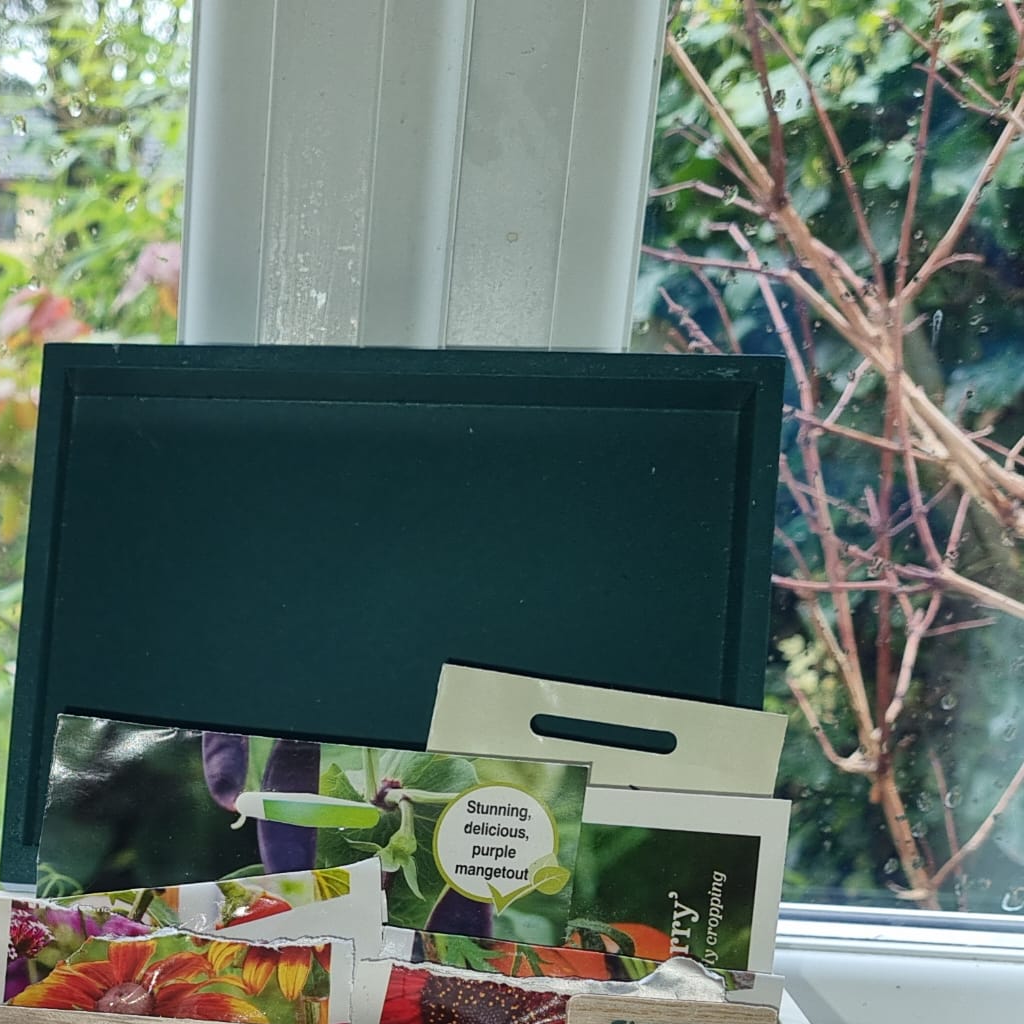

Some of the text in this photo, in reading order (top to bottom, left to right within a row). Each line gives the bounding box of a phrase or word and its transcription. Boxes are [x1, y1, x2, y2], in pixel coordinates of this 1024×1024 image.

[466, 799, 532, 822] Stunning,
[463, 821, 530, 842] delicious,
[471, 844, 517, 861] purple
[454, 864, 530, 881] mangetout
[705, 870, 727, 946] cropping
